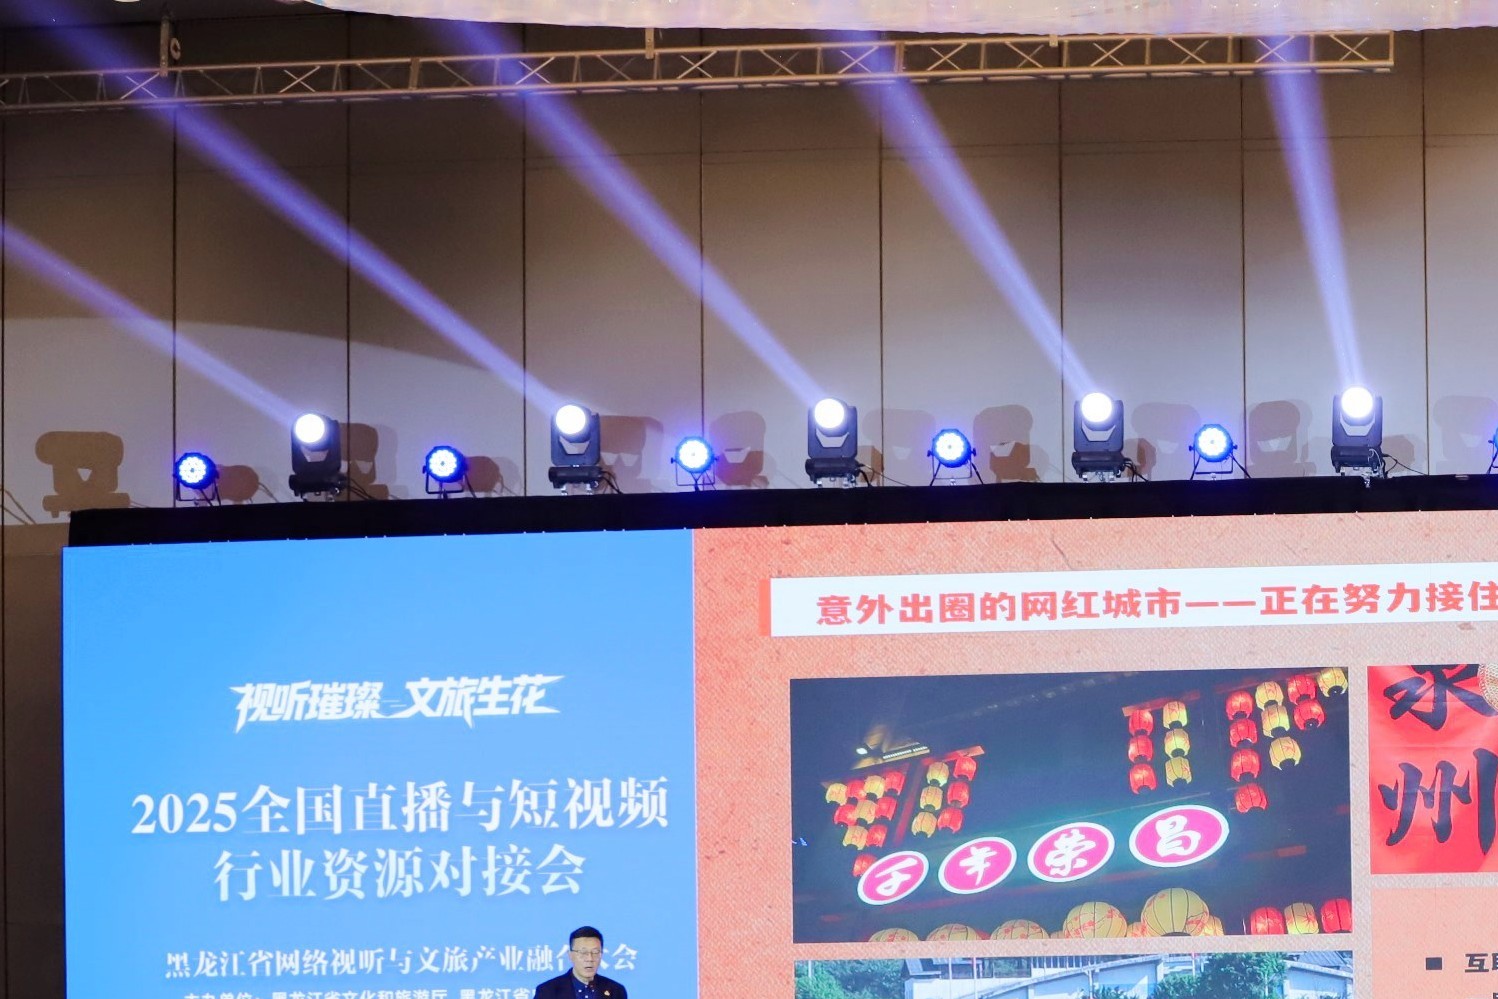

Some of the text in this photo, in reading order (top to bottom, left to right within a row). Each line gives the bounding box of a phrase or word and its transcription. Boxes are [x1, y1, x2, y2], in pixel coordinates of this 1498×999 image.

[230, 673, 566, 733] 视听璀璨 文旅生花
[130, 776, 670, 835] 2025全国直播与短视频
[213, 844, 586, 902] 行业资源对接会
